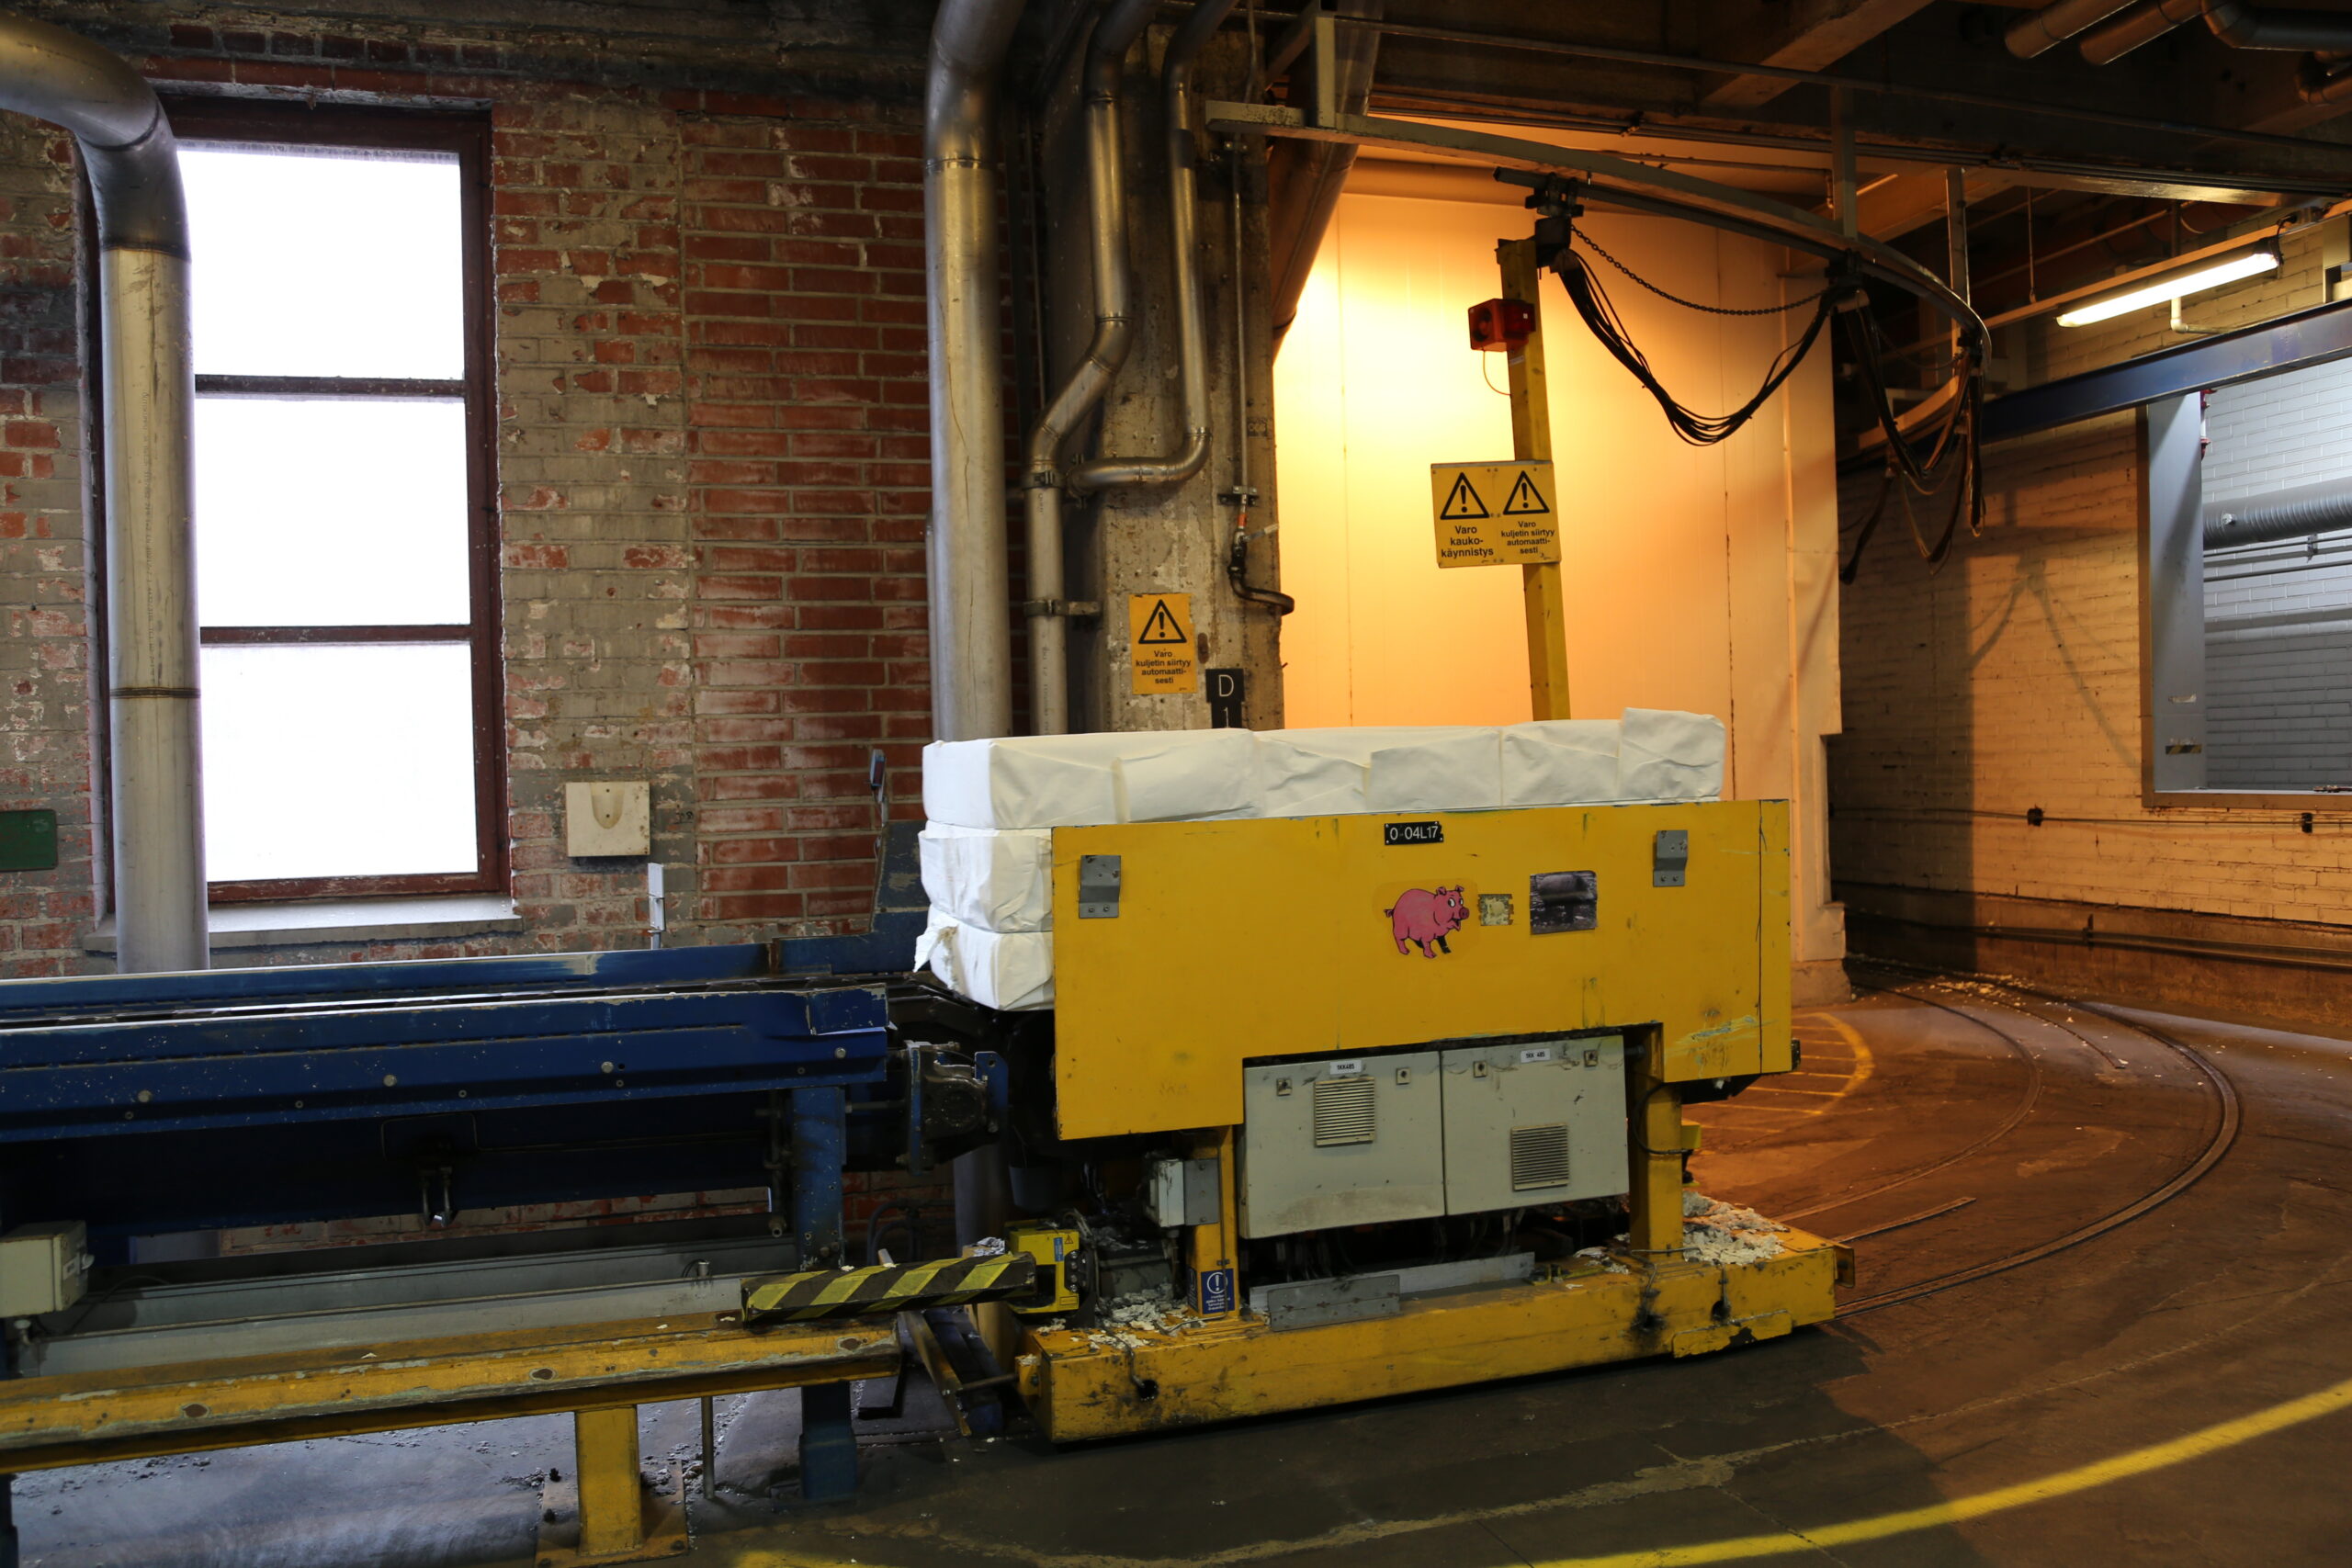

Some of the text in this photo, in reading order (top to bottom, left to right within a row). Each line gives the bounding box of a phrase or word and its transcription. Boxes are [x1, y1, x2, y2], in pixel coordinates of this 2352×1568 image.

[1454, 525, 1477, 535] Varo
[1500, 528, 1555, 538] kuljetin siirtyy
[1450, 536, 1484, 547] kauko-
[1507, 537, 1551, 547] automaatti-
[1441, 547, 1494, 559] käynnistys
[1136, 660, 1192, 668] kuljetin siirtyy
[1218, 674, 1235, 697] D
